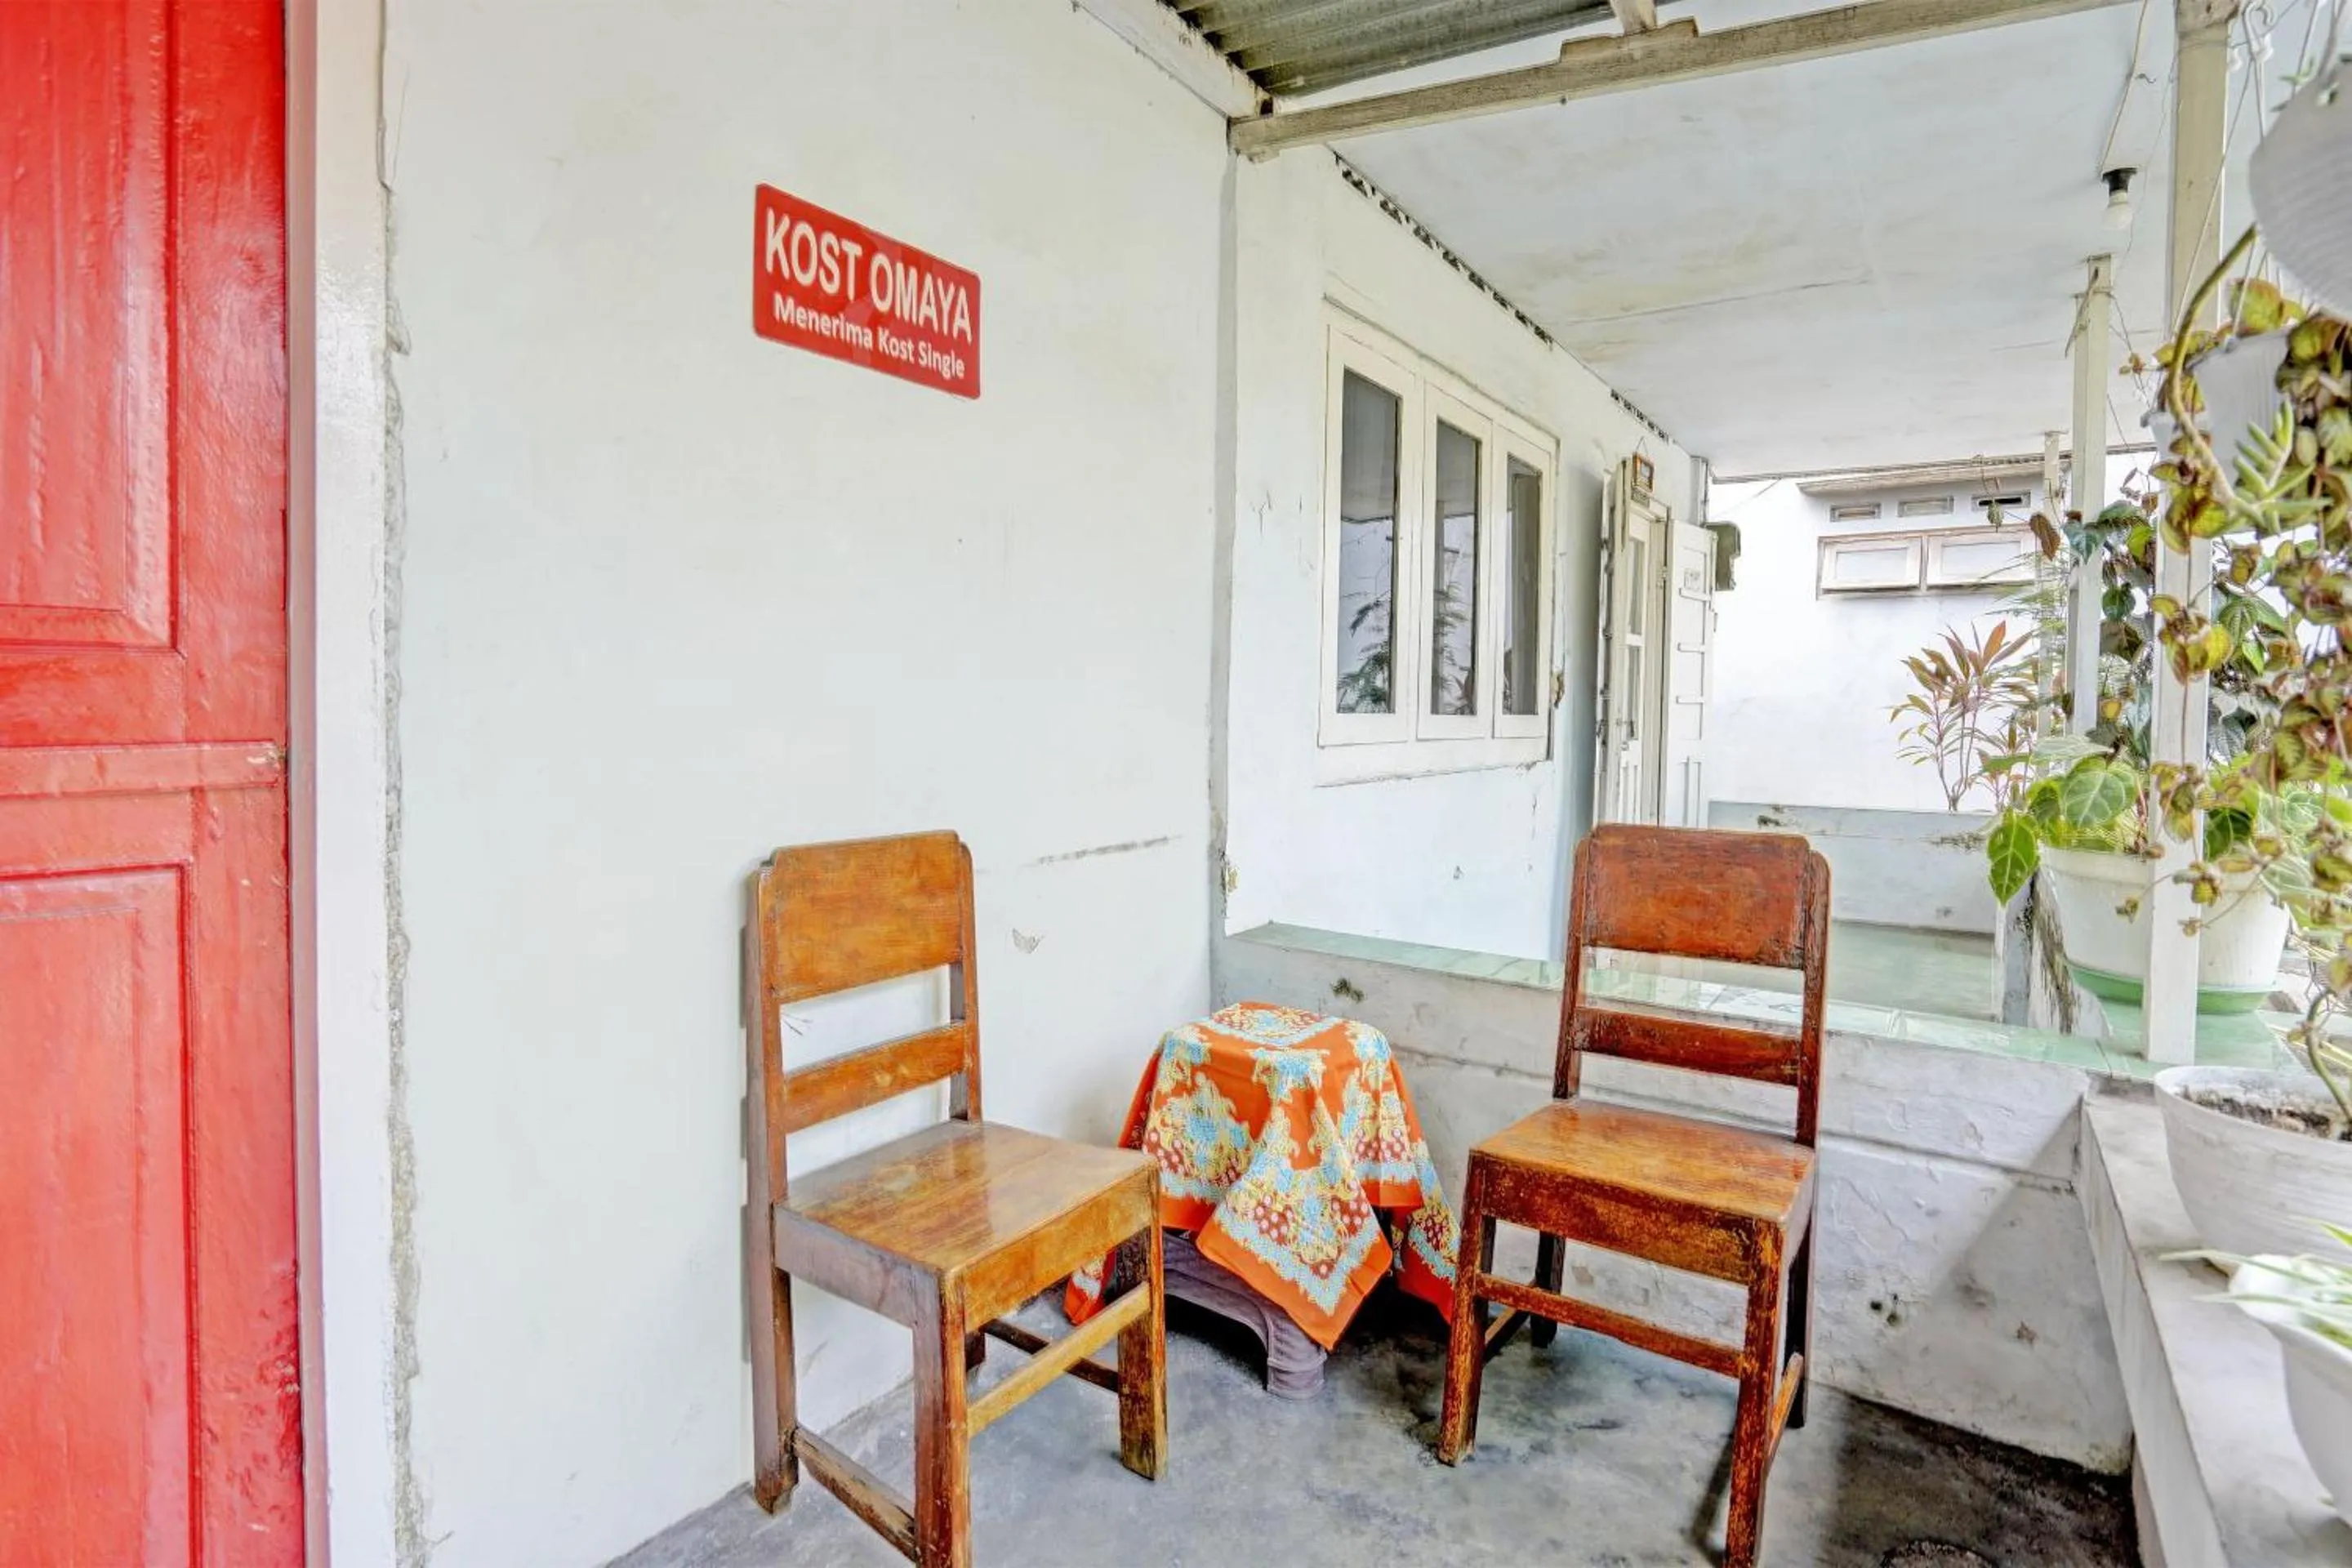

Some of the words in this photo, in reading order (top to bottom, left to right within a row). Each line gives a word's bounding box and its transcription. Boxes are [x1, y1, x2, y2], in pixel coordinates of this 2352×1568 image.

[765, 207, 862, 302] KOST
[870, 253, 973, 344] OMAYA
[774, 292, 873, 350] Menerima
[878, 327, 915, 363] Kost
[918, 341, 965, 380] Single
